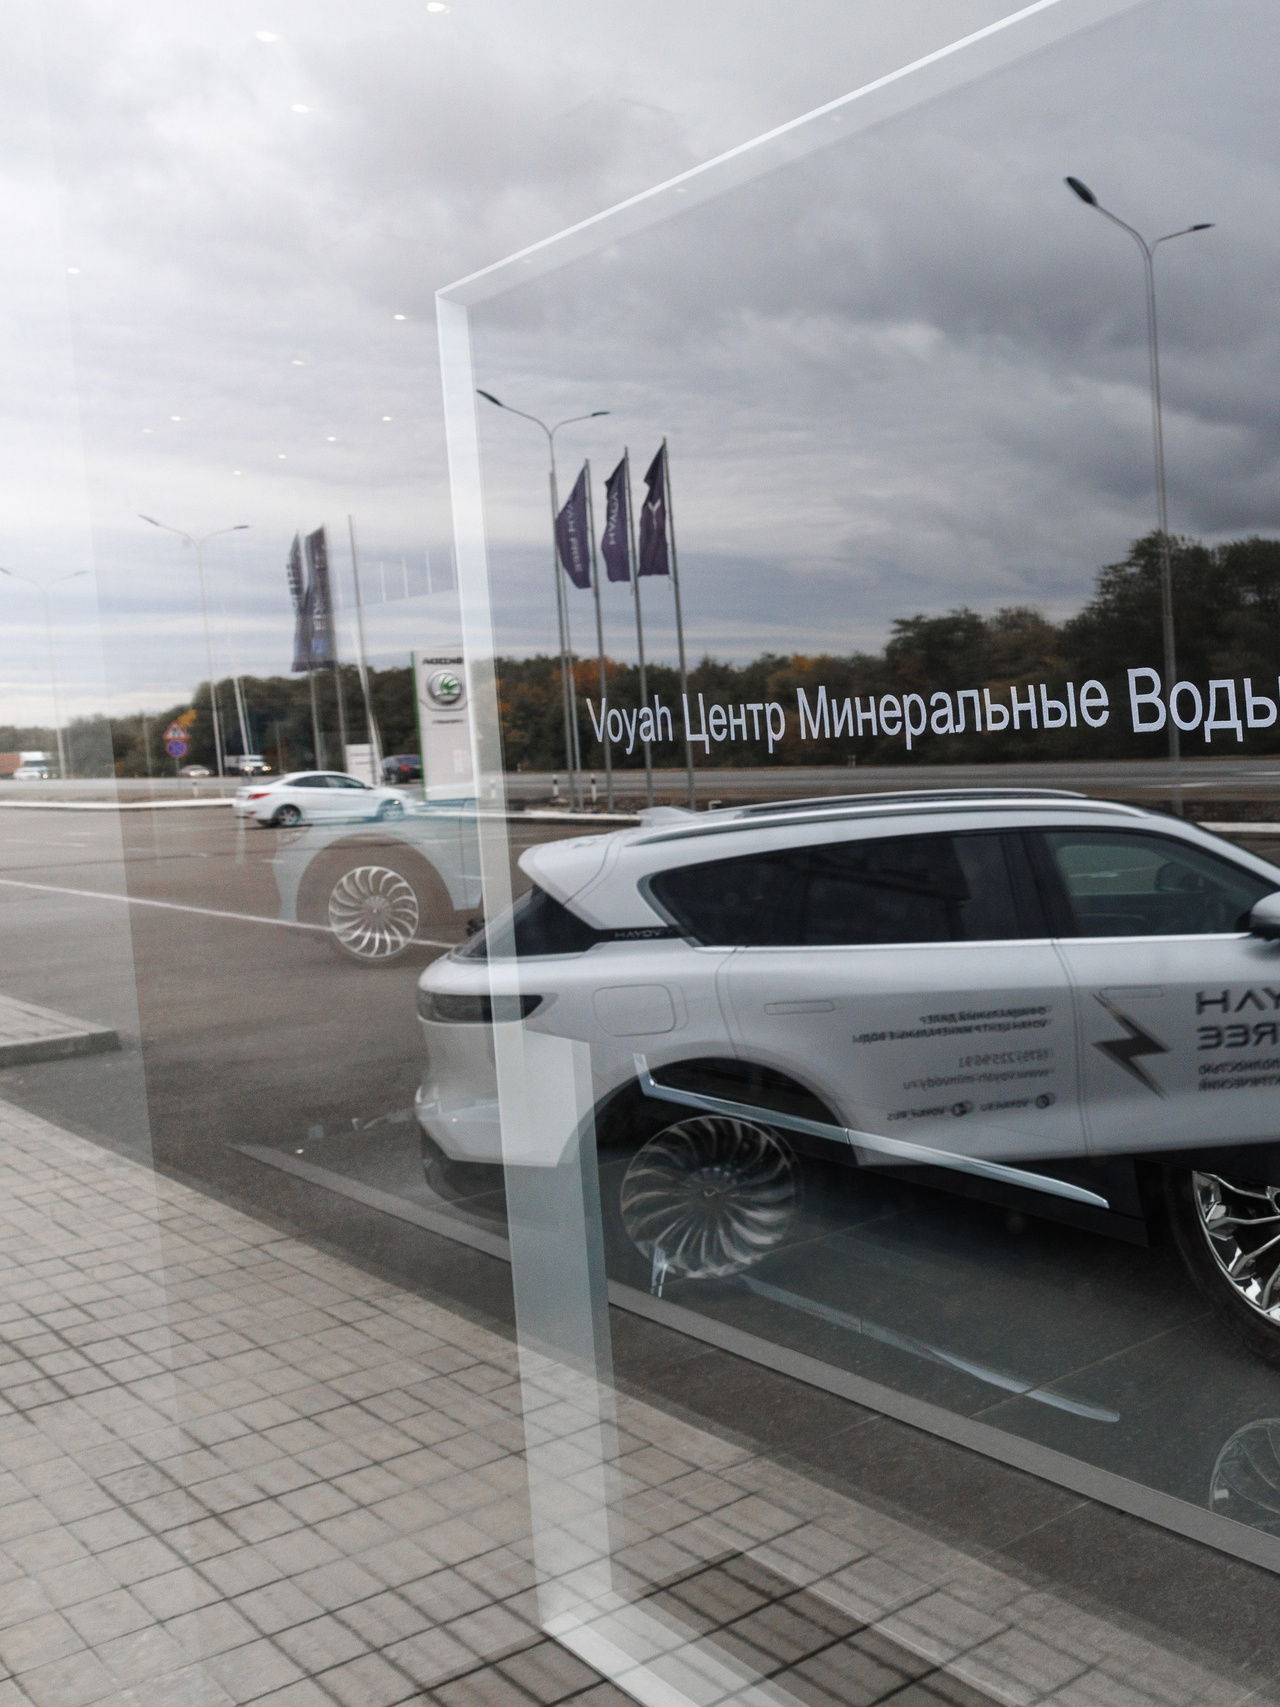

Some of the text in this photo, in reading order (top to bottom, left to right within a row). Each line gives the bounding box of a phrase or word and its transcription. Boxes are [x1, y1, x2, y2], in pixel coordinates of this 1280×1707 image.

[585, 694, 673, 755] Voyah
[682, 692, 786, 754] Центр
[799, 679, 1109, 751] Минеральные
